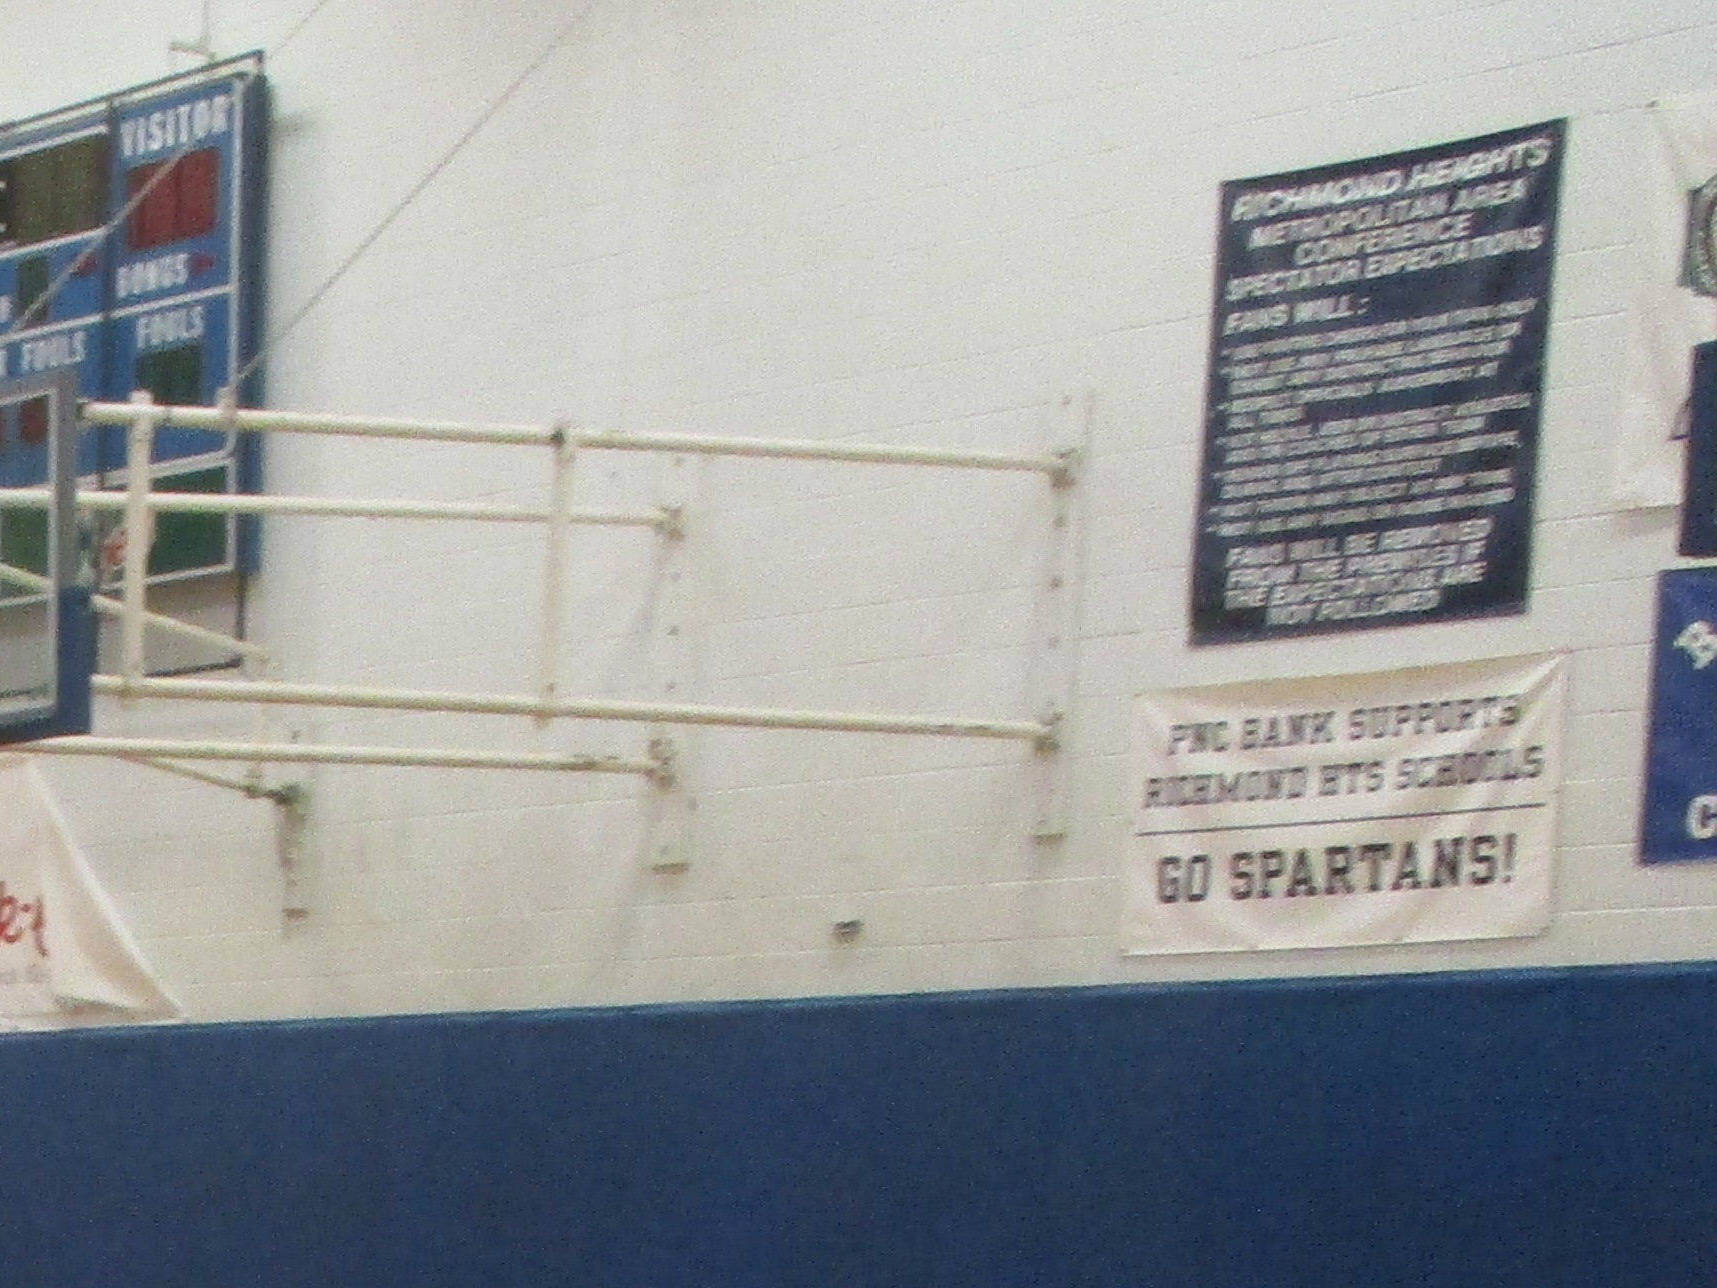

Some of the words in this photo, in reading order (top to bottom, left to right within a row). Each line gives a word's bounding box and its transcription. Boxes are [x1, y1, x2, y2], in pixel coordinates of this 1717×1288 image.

[121, 93, 231, 158] VISITOR
[1230, 168, 1405, 222] RICHMOND
[1405, 138, 1553, 191] HEIGHTS
[1247, 194, 1451, 251] METROPOLITAN
[1451, 177, 1530, 212] AREA
[1294, 212, 1475, 266] CONFERENCE
[117, 253, 190, 299] BONUS
[1225, 258, 1362, 303] SPECTATOR
[1364, 225, 1546, 278] EXPECTATIONS
[136, 304, 205, 350] FOULS
[1223, 303, 1289, 337] FANS
[20, 330, 87, 375] FOULS
[1167, 722, 1230, 757] PNC
[1239, 711, 1336, 751] BANK
[1347, 693, 1523, 742] SUPPORTS
[1142, 764, 1308, 809] RICHMOND
[1397, 745, 1545, 791] SCHOOLS
[1156, 852, 1212, 904] GO
[1229, 832, 1519, 901] SPARTANS!
